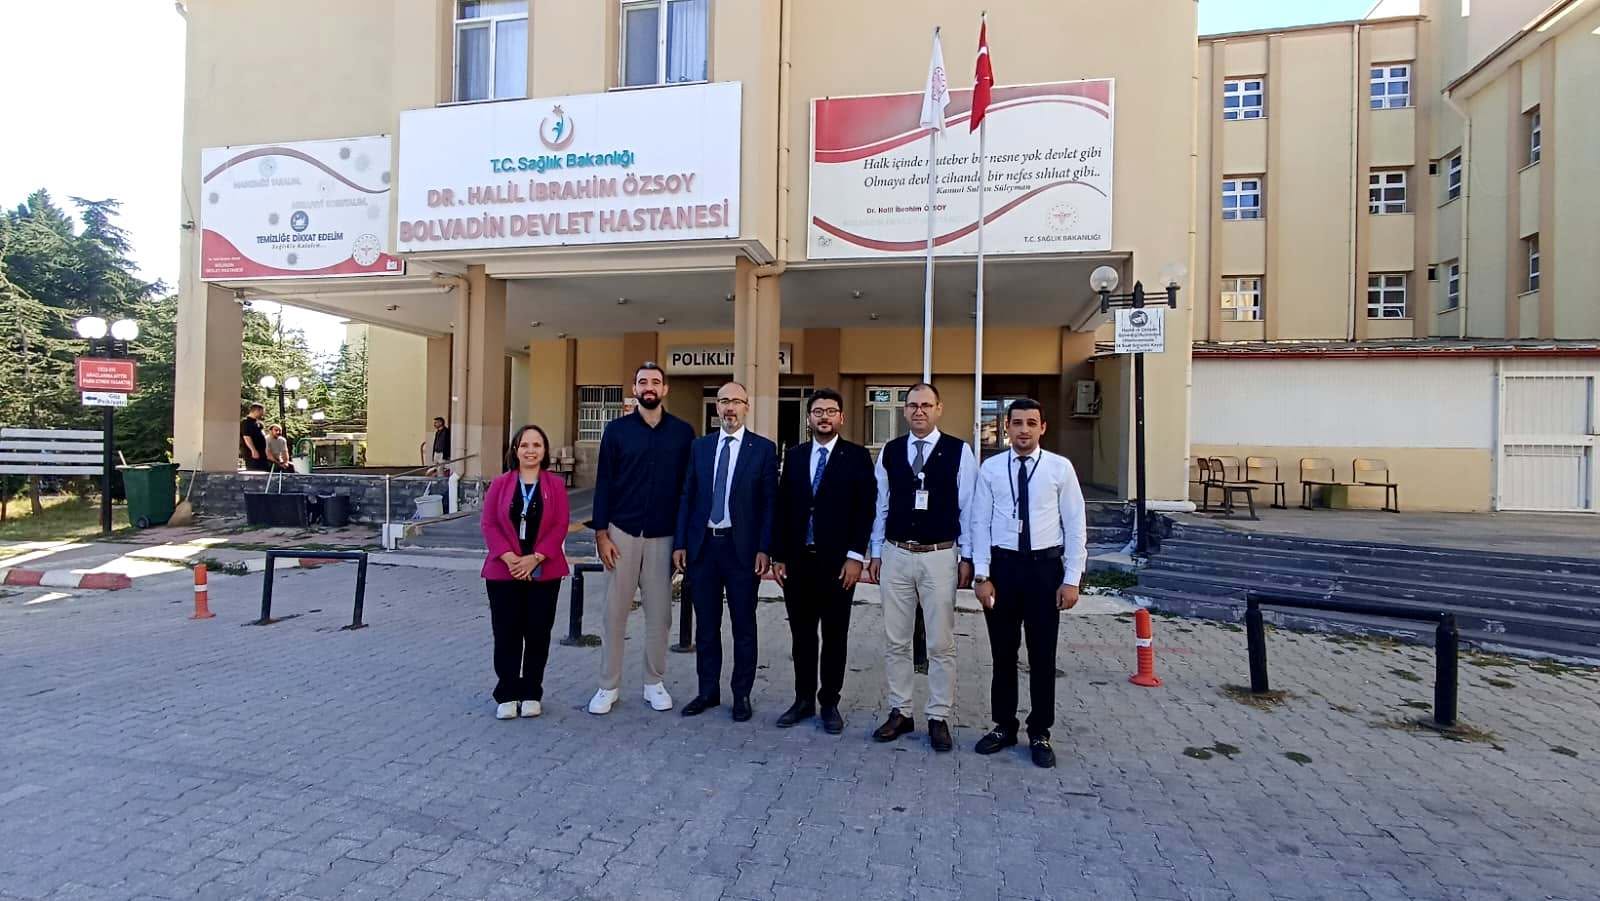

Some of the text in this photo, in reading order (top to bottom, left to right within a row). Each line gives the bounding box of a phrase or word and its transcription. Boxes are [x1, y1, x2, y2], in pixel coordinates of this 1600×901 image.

[490, 149, 635, 174] T.C. Sağlık Bakanlığı
[863, 158, 890, 170] Halk
[892, 155, 923, 170] içinde
[989, 153, 1020, 163] nesne
[1020, 149, 1042, 165] yok
[1044, 147, 1077, 160] devlet
[1079, 146, 1102, 162] gibi
[468, 180, 525, 205] HALİL
[529, 175, 617, 201] İBRAHİM
[622, 172, 696, 195] ÖZSOY
[863, 175, 906, 189] Olmaya
[908, 173, 939, 185] devlt
[987, 169, 1004, 182] bir
[1006, 168, 1033, 183] nefes
[1035, 166, 1071, 179] sıhhat
[966, 185, 992, 193] Sulan
[993, 184, 1032, 193] Süleyman
[399, 198, 730, 243] BOLVADİN DEVLET HASTANESİ
[256, 231, 344, 244] TEMİZLİĞE DİKKAT EDELİM
[672, 349, 785, 366] POLİKLİR
